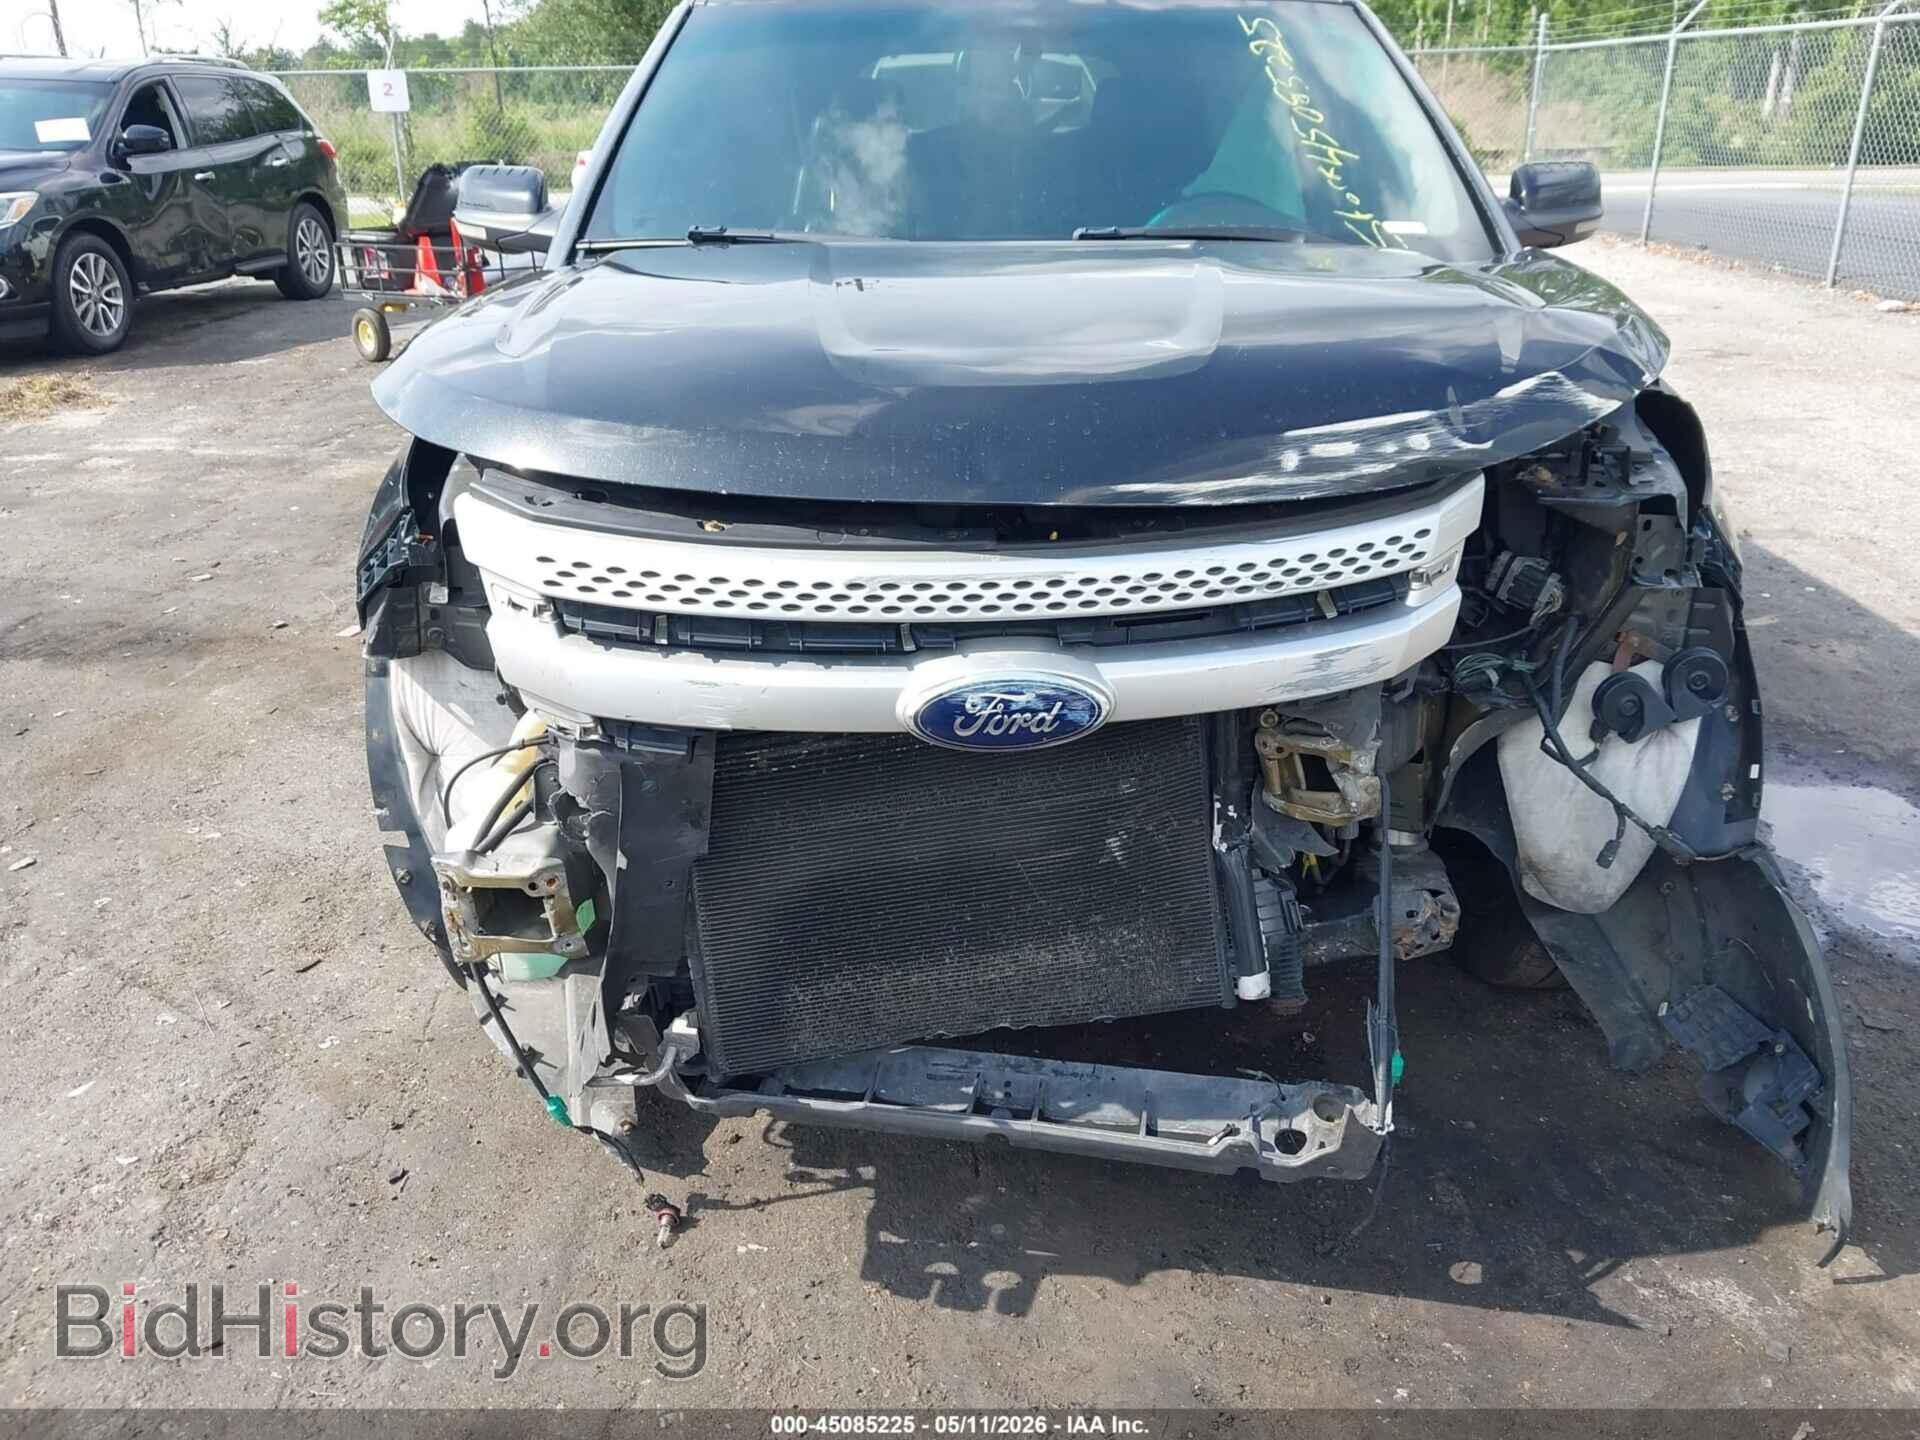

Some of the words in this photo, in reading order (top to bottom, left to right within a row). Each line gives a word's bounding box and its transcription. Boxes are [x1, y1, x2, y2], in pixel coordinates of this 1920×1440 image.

[383, 82, 394, 96] 2
[1237, 14, 1360, 166] 45085225
[953, 691, 1063, 737] Ford
